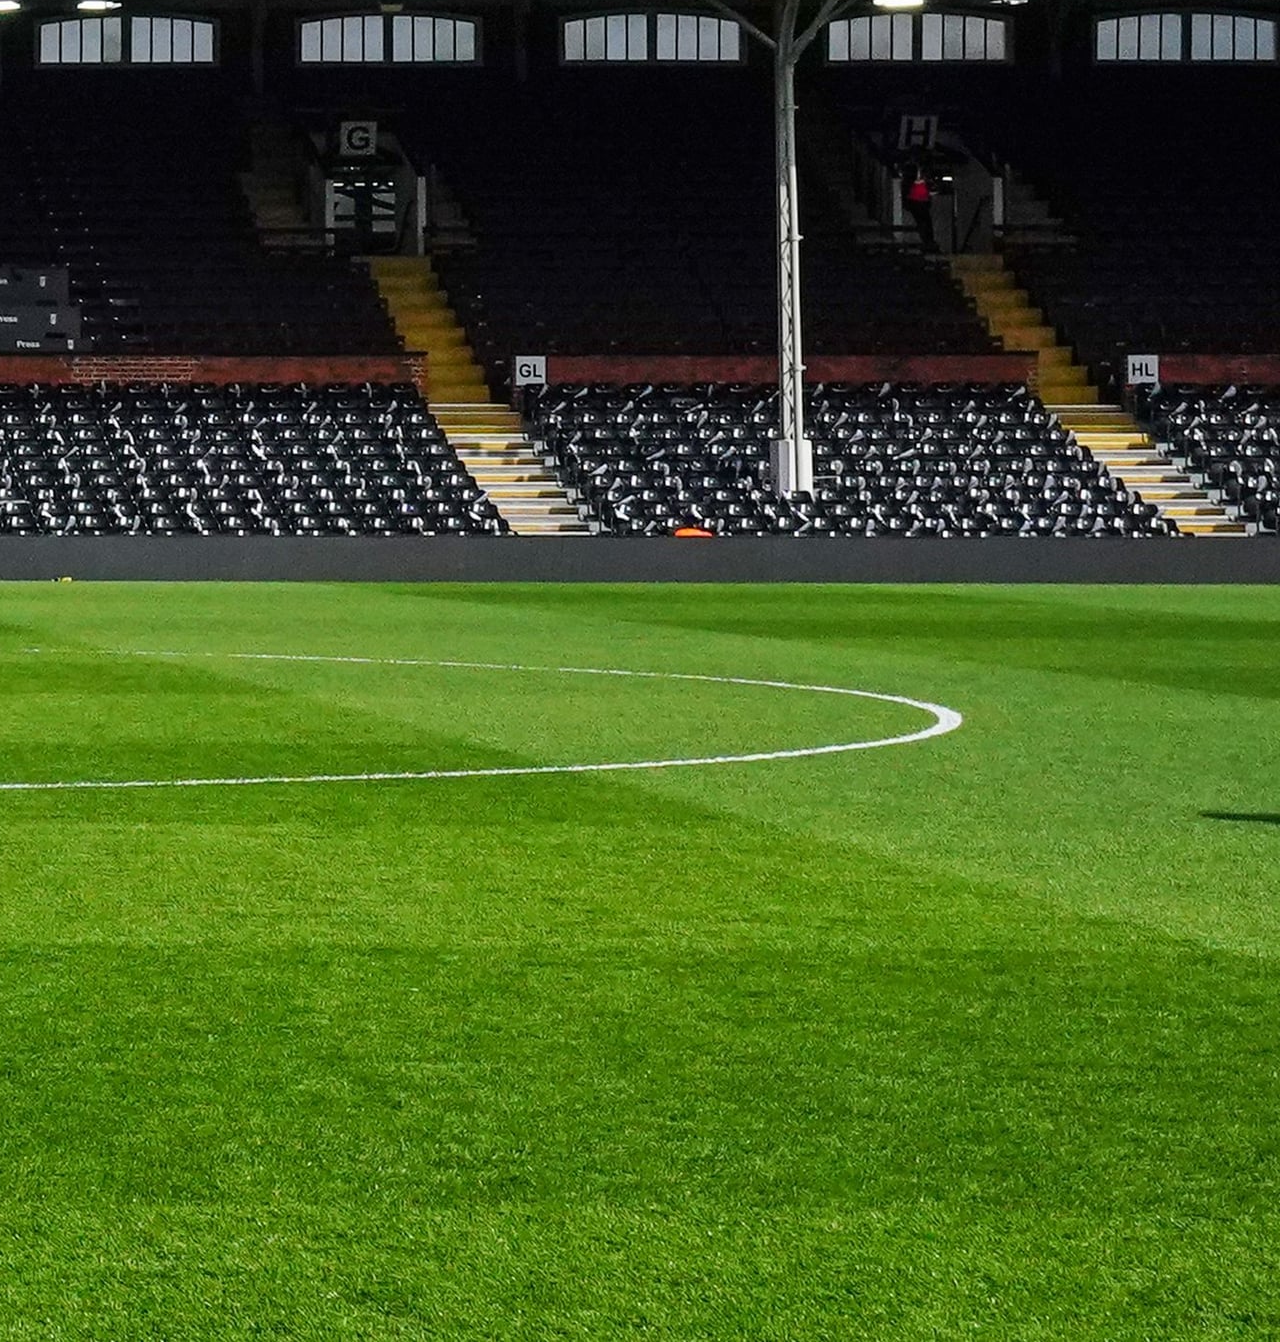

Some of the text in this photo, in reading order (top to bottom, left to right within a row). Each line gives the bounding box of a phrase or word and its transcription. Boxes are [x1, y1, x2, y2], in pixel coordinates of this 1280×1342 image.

[347, 126, 371, 150] G
[905, 117, 931, 146] H
[16, 340, 40, 349] Press
[519, 363, 543, 378] GL
[1132, 362, 1154, 377] HL
